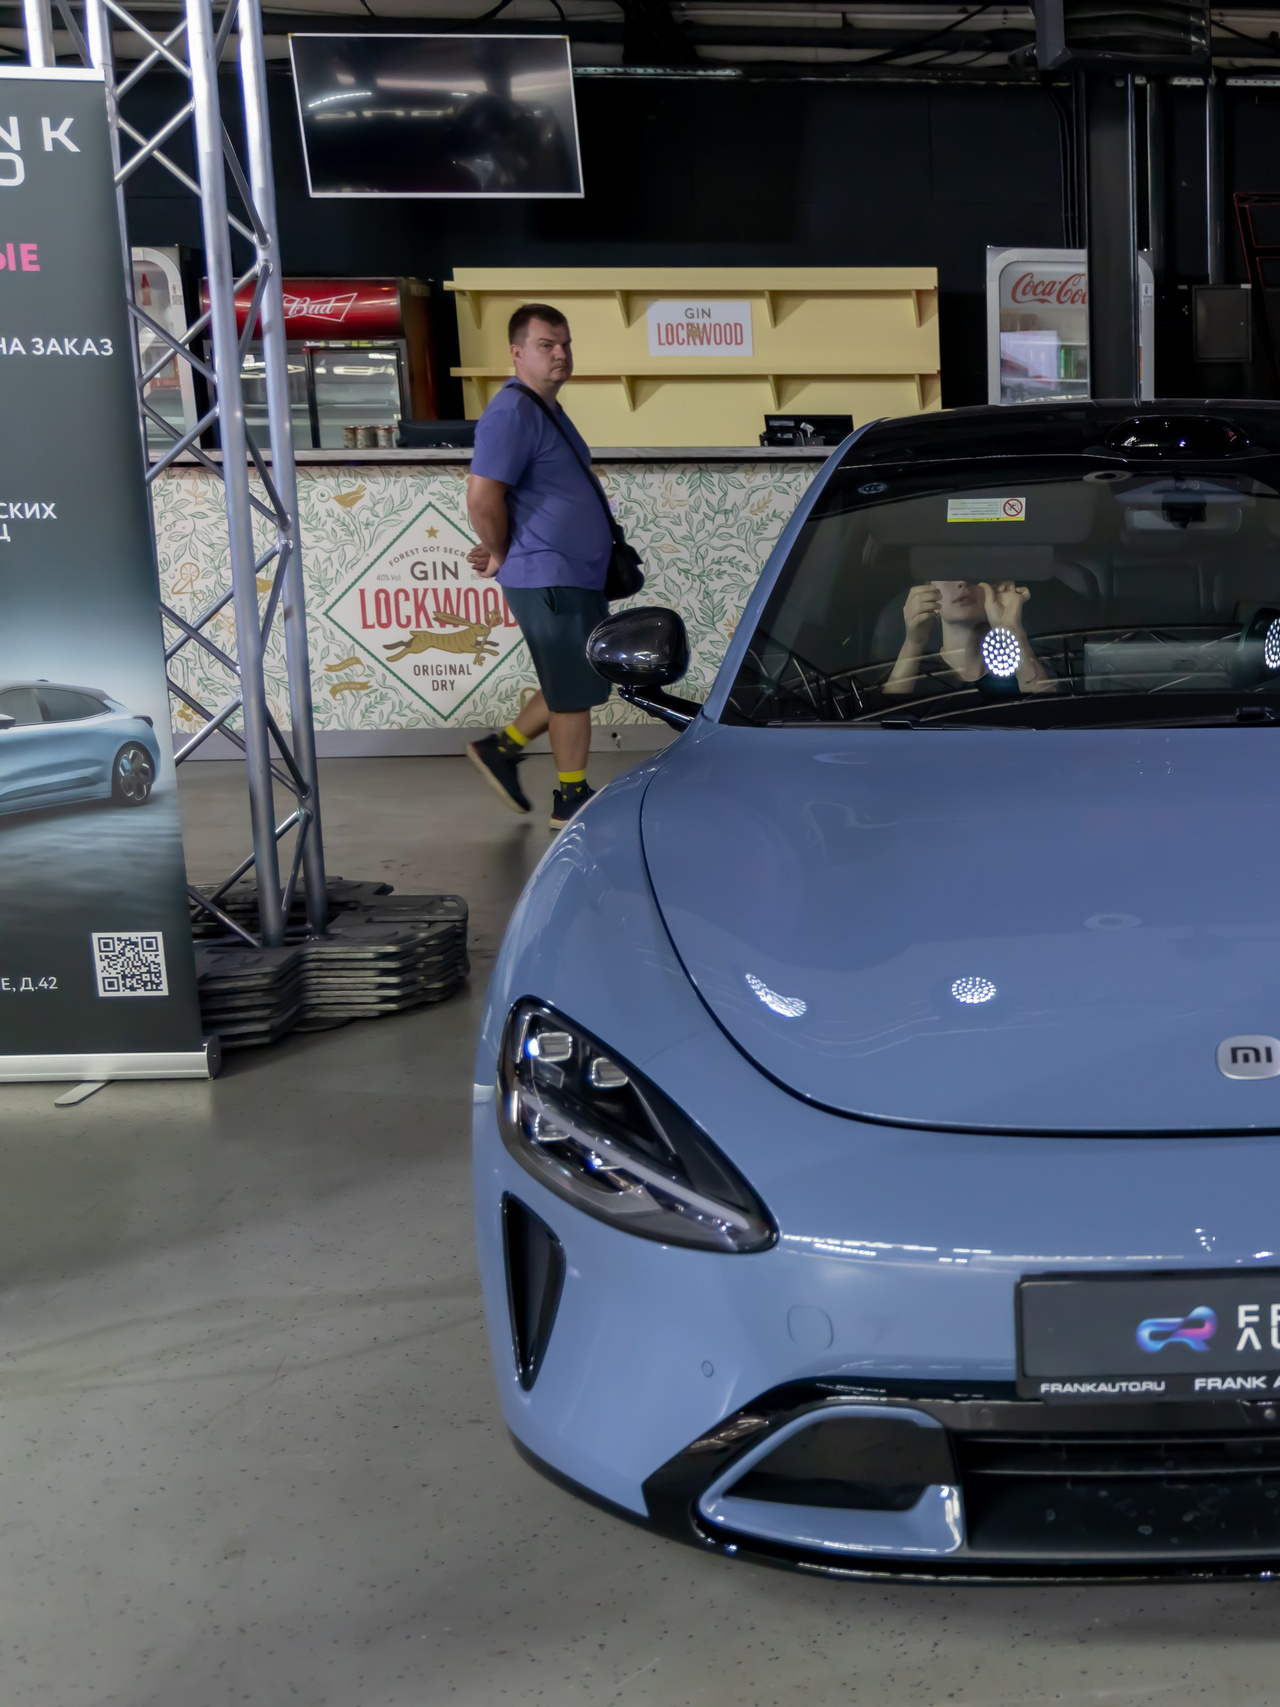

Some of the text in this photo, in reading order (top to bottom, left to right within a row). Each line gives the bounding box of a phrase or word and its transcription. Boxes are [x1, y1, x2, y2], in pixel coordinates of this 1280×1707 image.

[1010, 272, 1087, 305] Coca-Co
[284, 296, 335, 316] Bud
[684, 307, 711, 319] GIN
[656, 322, 744, 346] LOCKWOOD
[31, 337, 114, 356] ЗАКАЗ
[388, 547, 420, 567] FOREST
[443, 546, 466, 558] SECR
[410, 560, 460, 581] GIN
[413, 664, 472, 676] ORIGINAL
[431, 679, 456, 692] DRY
[1194, 1375, 1268, 1391] FRANK
